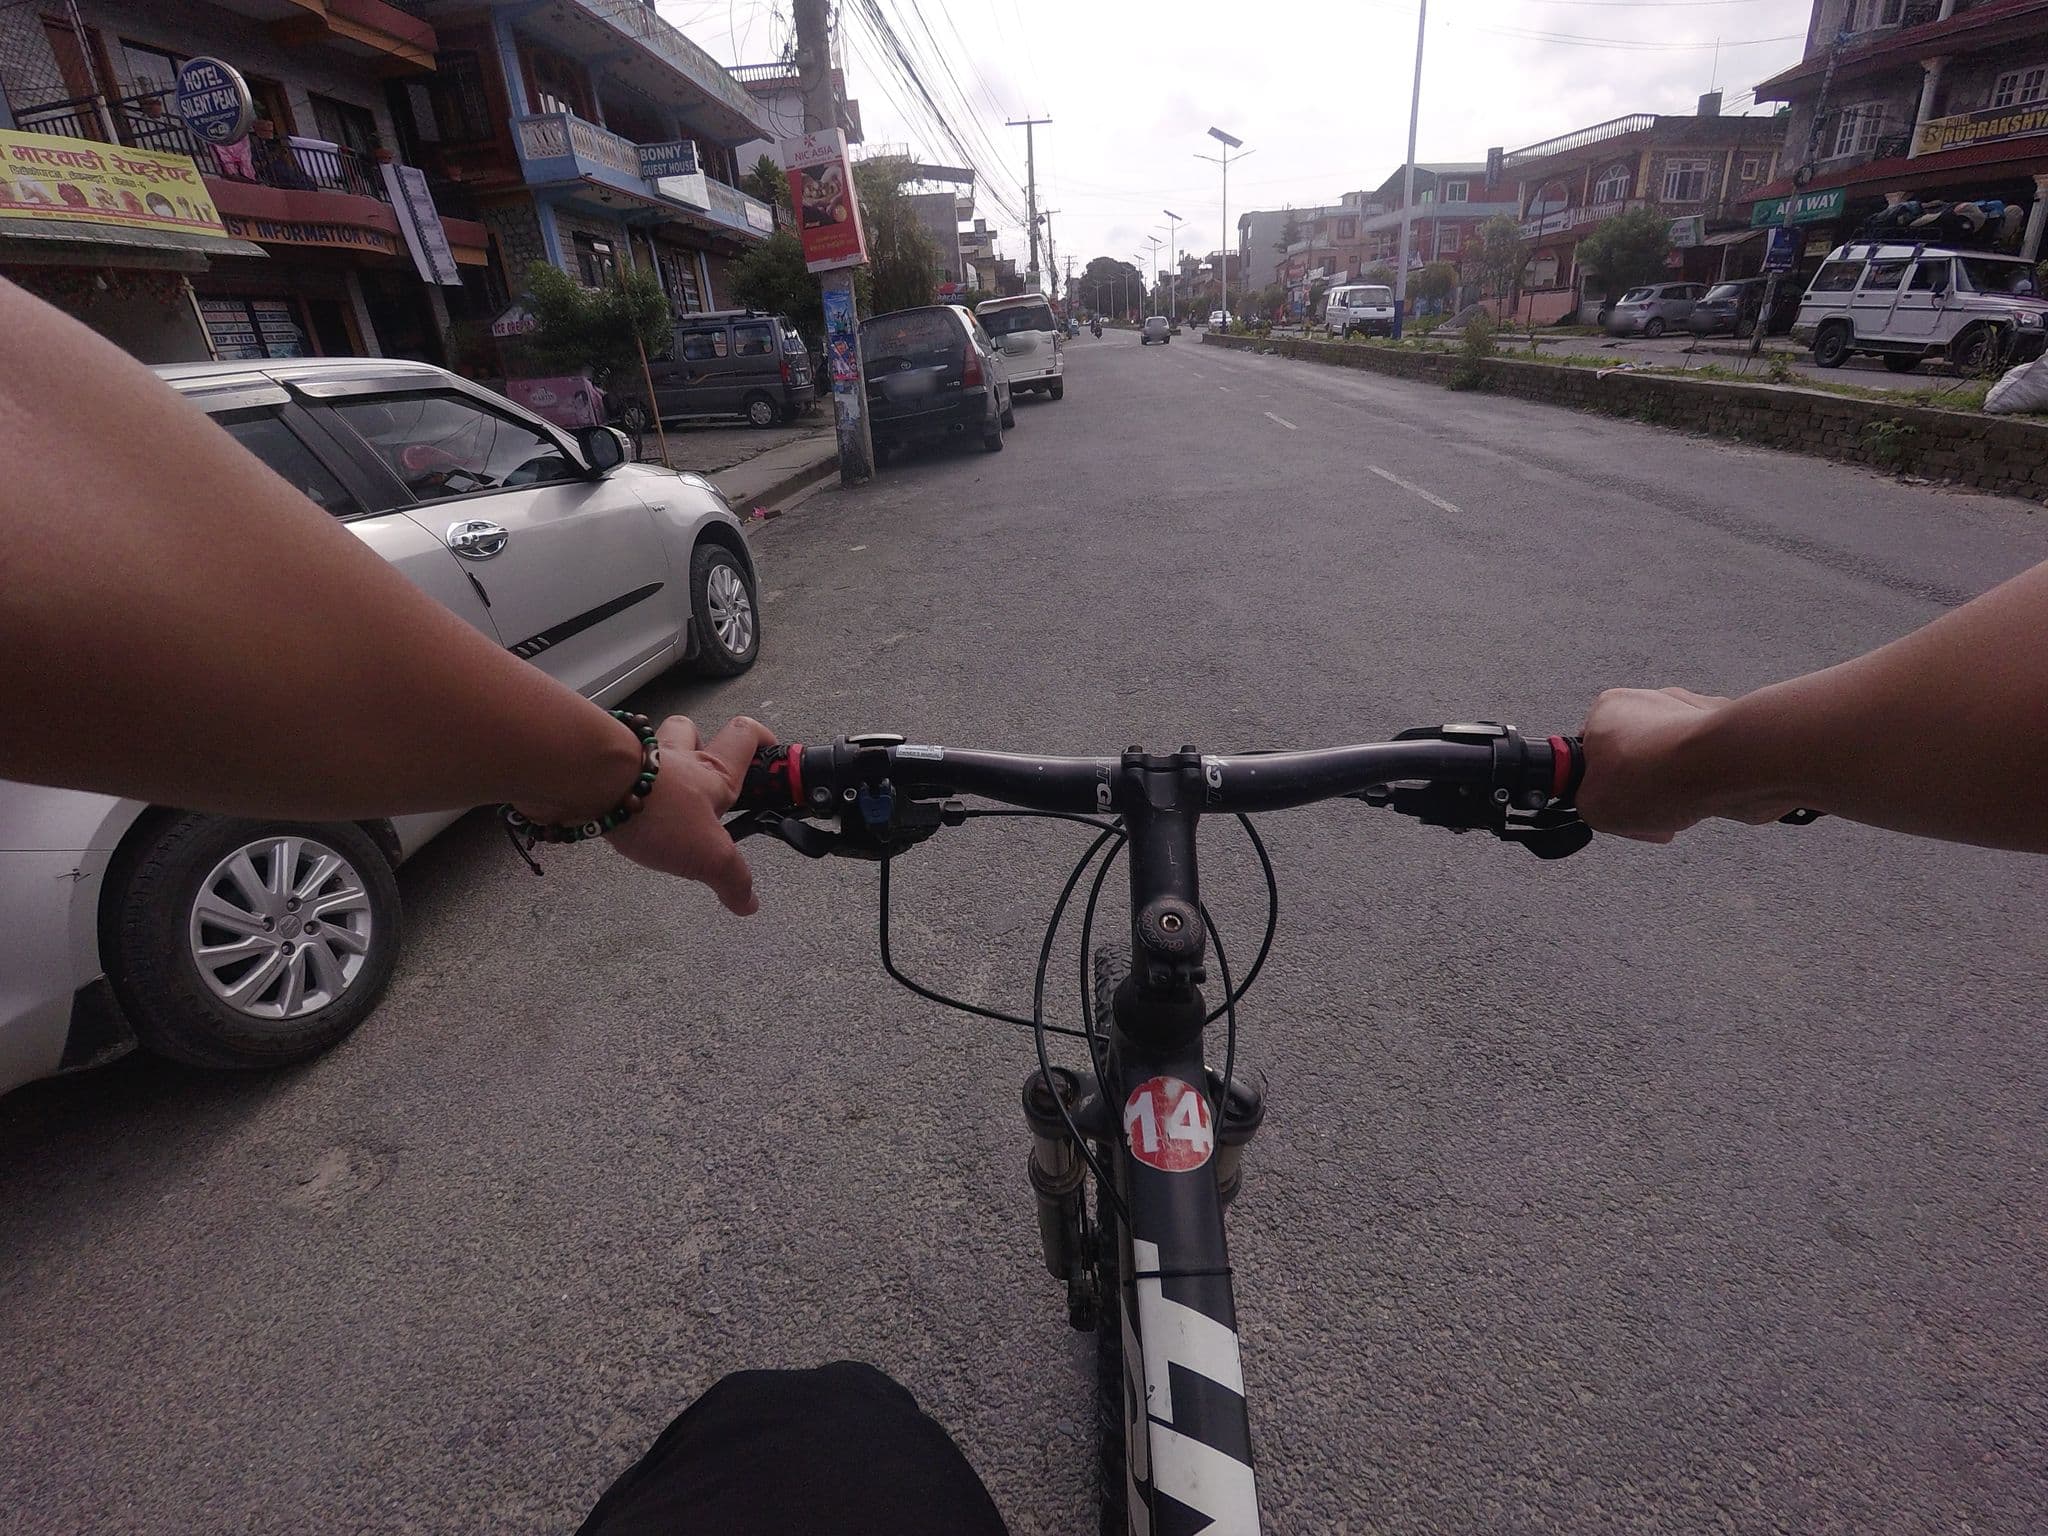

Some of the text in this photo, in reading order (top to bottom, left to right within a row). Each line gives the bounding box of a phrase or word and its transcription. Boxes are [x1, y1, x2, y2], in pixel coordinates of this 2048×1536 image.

[182, 65, 223, 93] HOTEL
[181, 93, 213, 119] SILENT
[211, 87, 240, 111] PEAK
[640, 145, 682, 161] BONNY
[795, 145, 834, 162] NIC ASIA
[642, 159, 695, 176] GUEST HOUSE
[1806, 192, 1839, 211] WAY
[1125, 1091, 1211, 1153] 14
